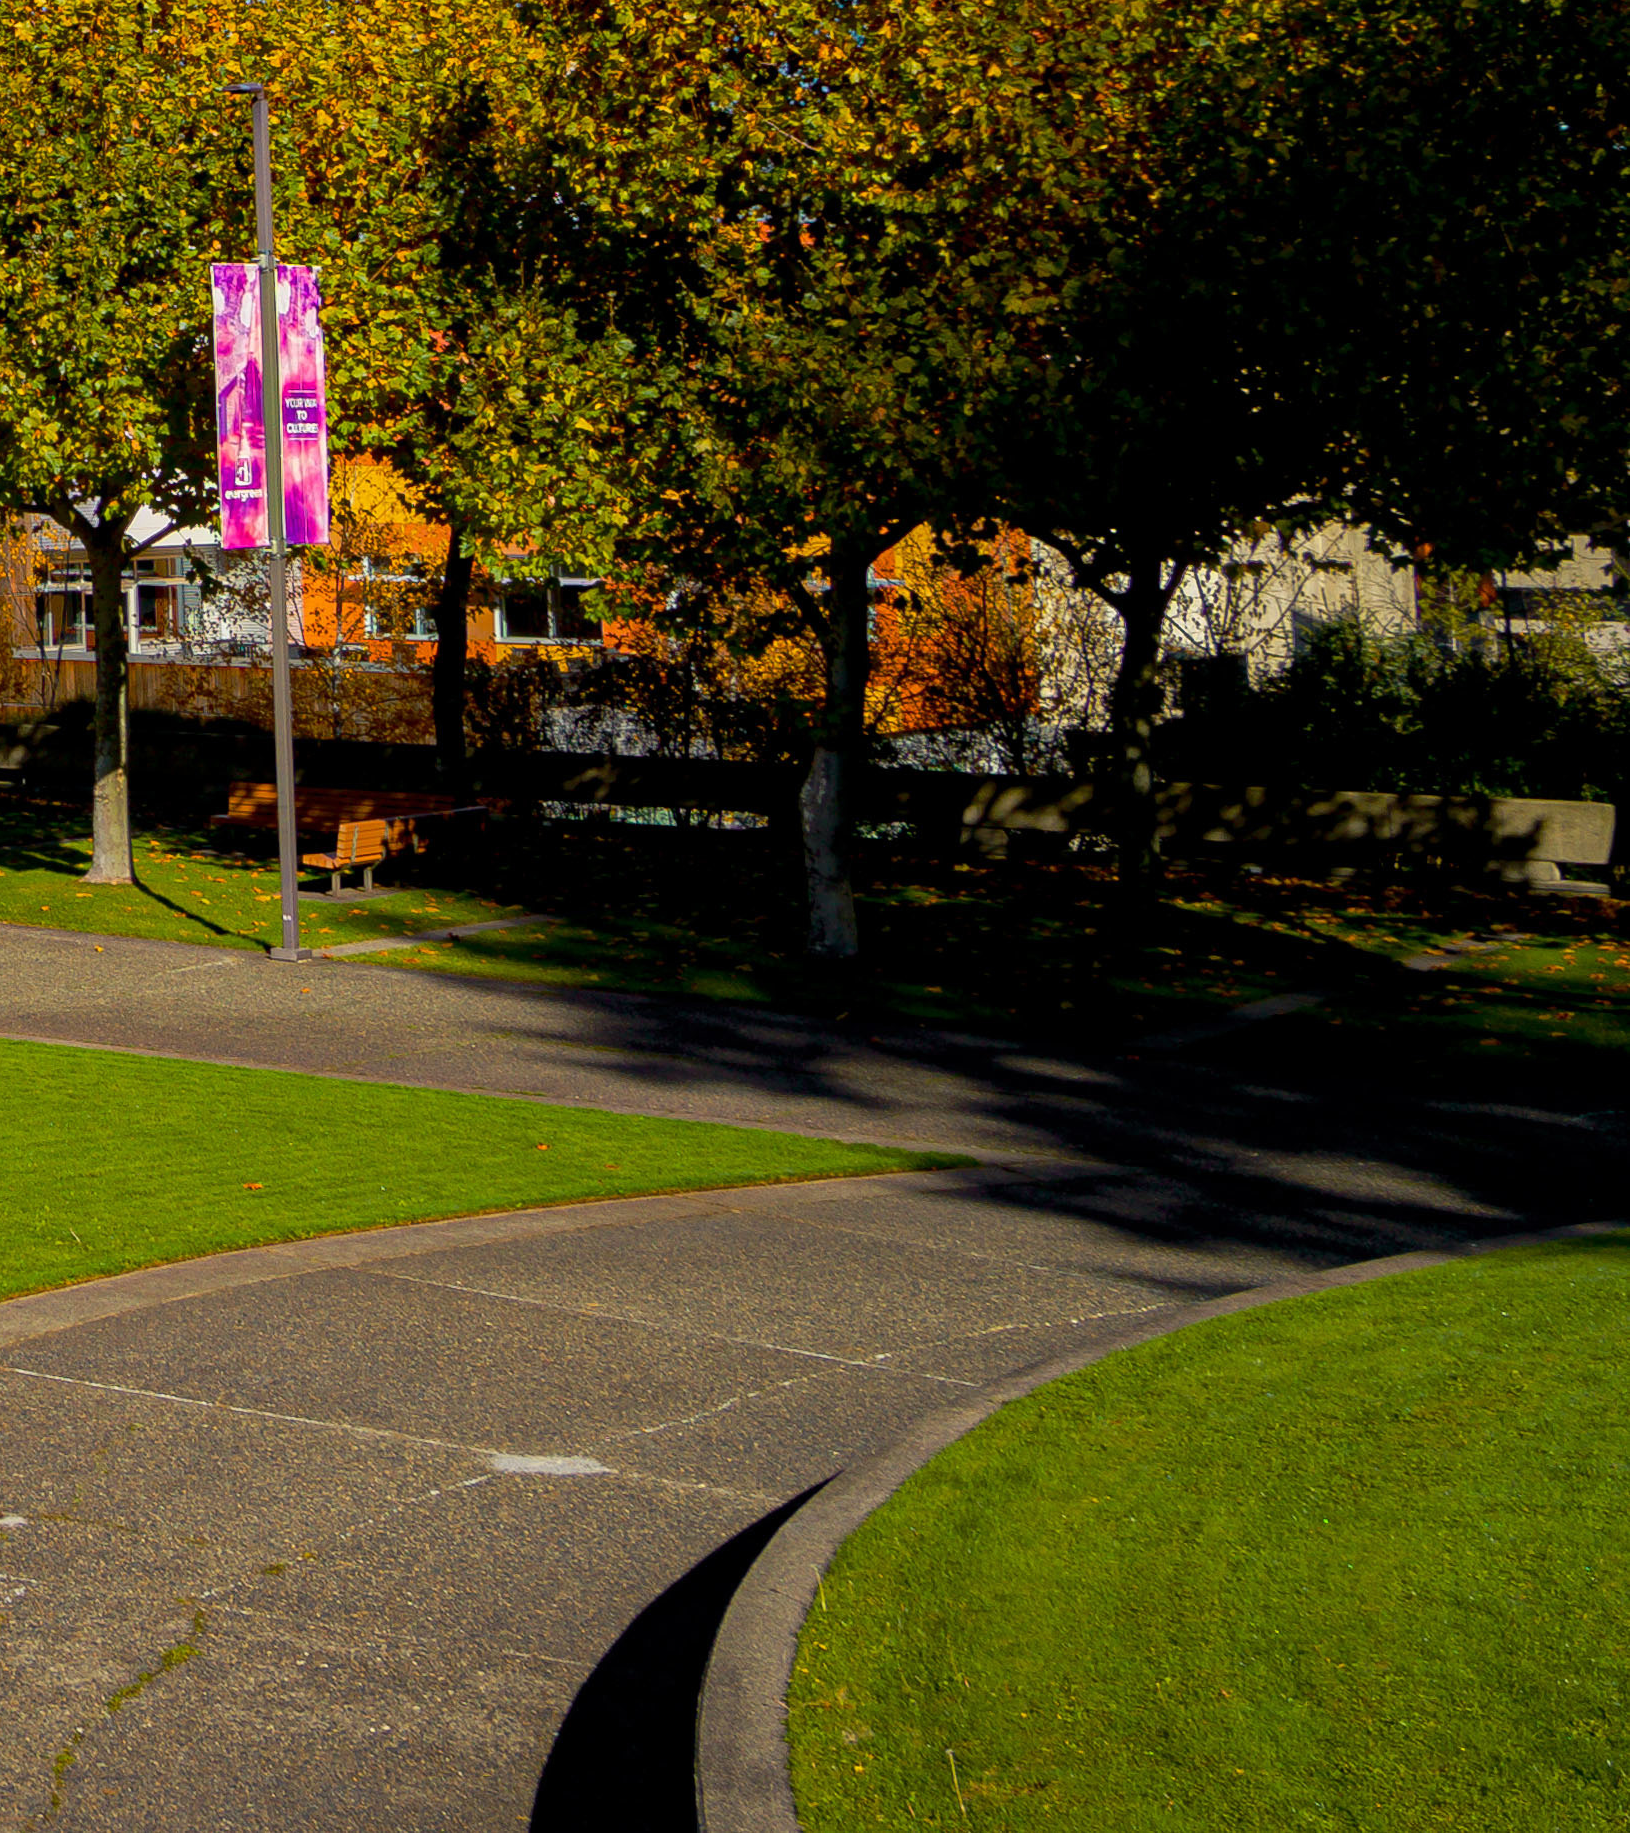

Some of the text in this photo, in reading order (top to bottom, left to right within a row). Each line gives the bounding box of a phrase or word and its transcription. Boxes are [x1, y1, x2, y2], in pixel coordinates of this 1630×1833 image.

[285, 398, 304, 408] YOUR
[296, 410, 308, 420] TO
[225, 489, 263, 502] evergreen
